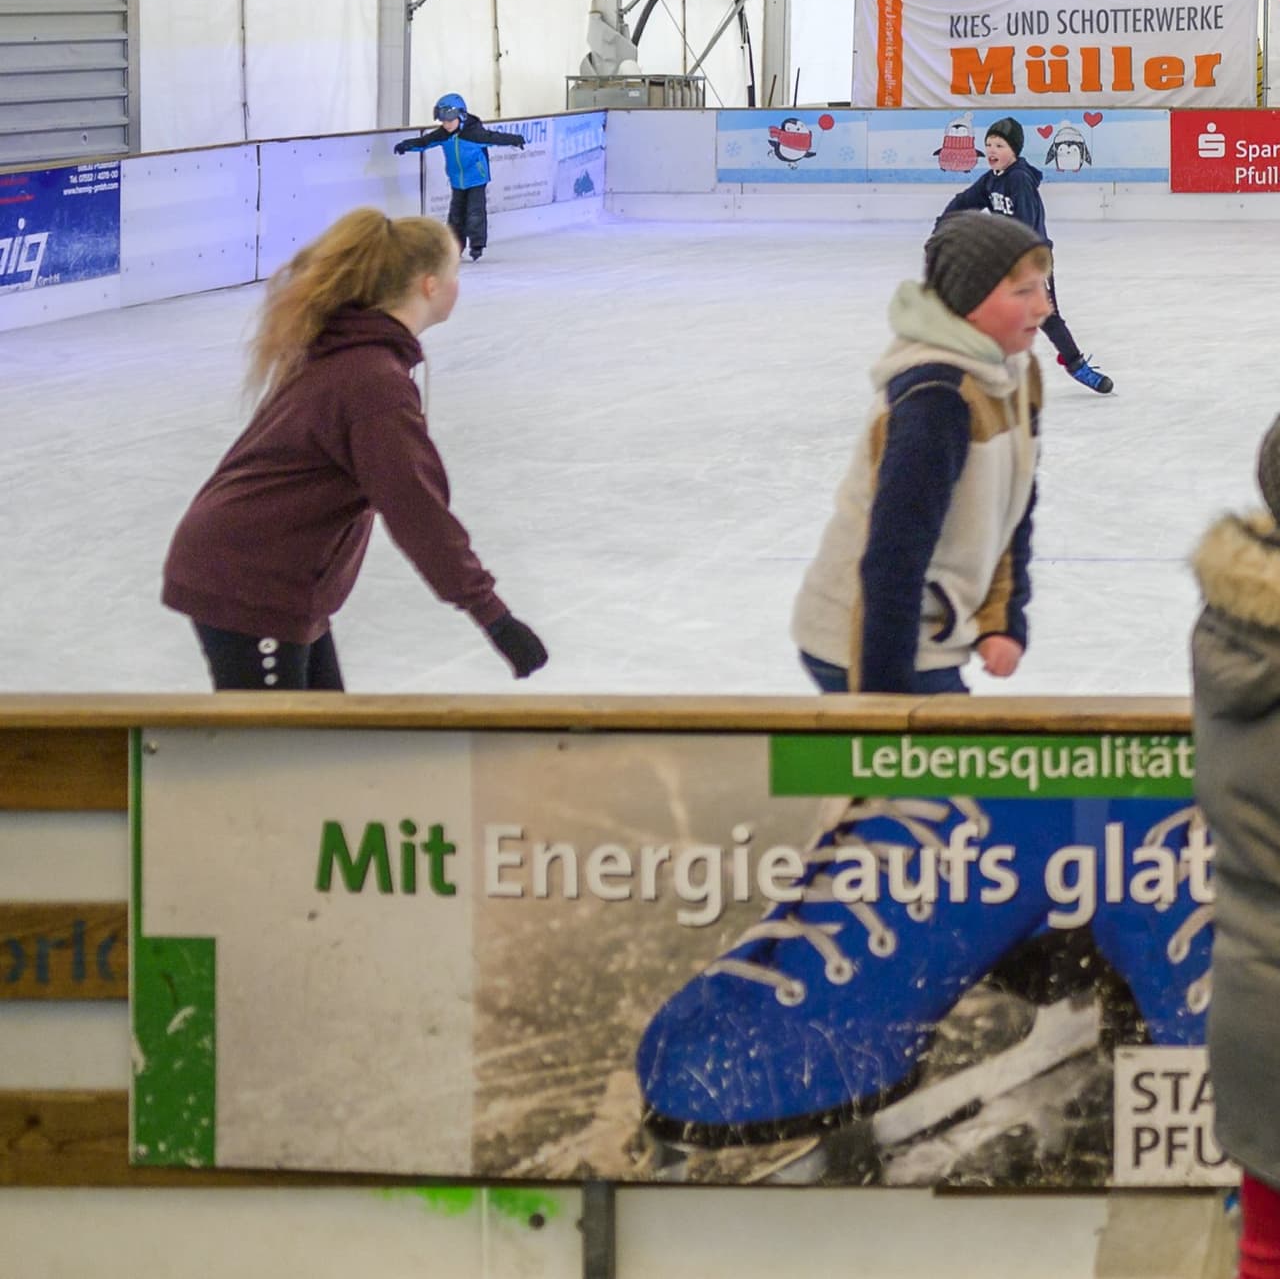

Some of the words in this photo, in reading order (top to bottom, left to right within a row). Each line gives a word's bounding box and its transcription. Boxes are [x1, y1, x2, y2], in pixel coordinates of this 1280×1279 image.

[950, 13, 998, 39] KIES-
[1007, 10, 1050, 37] UND
[1057, 5, 1225, 35] SCHOTTERWERKE
[950, 44, 1222, 96] Müller
[851, 735, 1196, 793] Lebensqualität
[316, 819, 457, 896] Mit
[484, 823, 806, 926] Energie
[831, 821, 1020, 905] aufs
